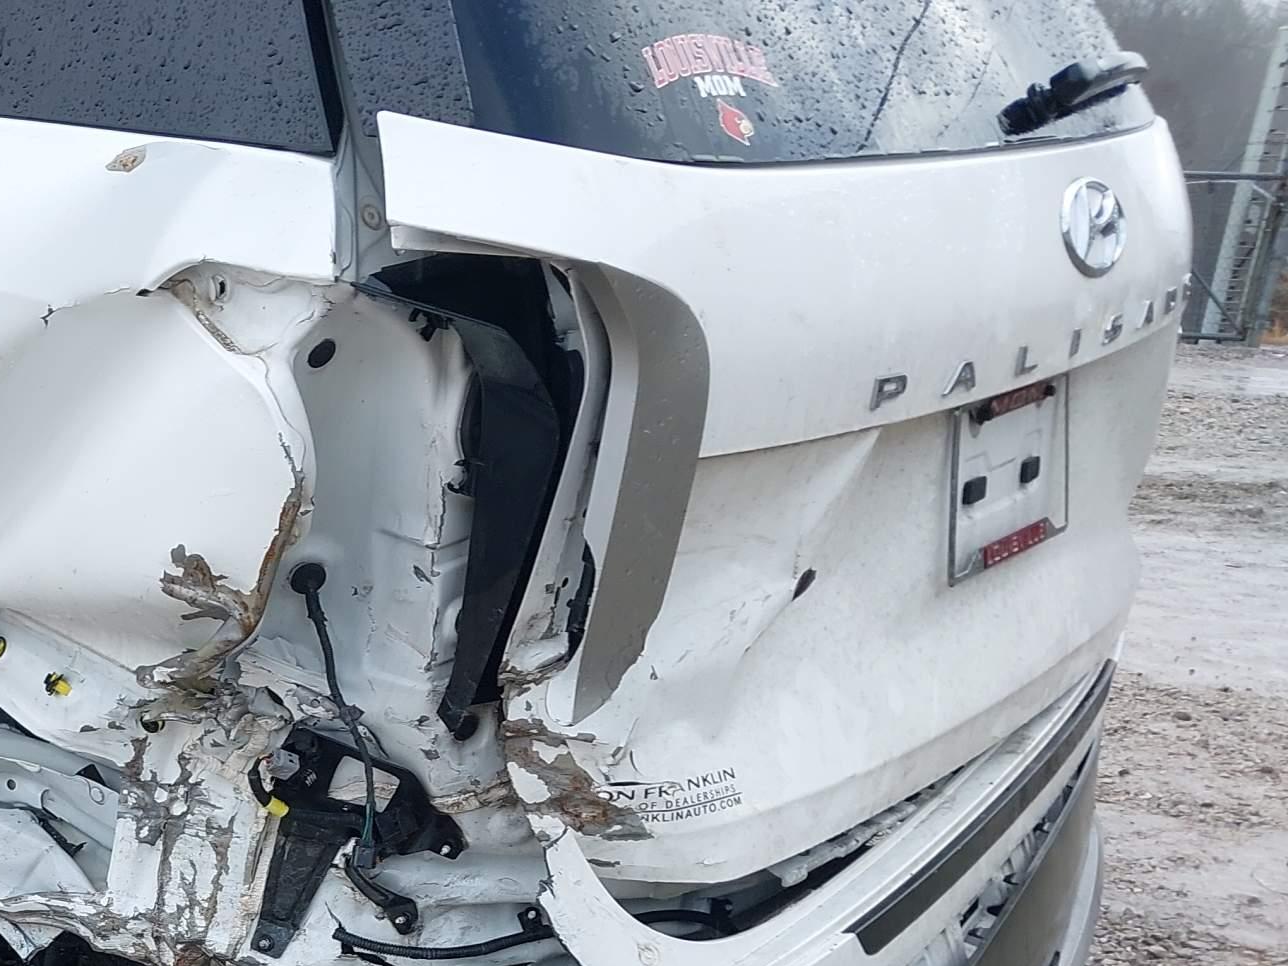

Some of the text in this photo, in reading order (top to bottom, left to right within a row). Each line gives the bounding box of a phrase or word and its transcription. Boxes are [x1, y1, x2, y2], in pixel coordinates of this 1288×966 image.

[641, 33, 779, 89] LOUISVILLE
[693, 75, 747, 98] MOM
[638, 784, 737, 811] OF DEALERSHIPS
